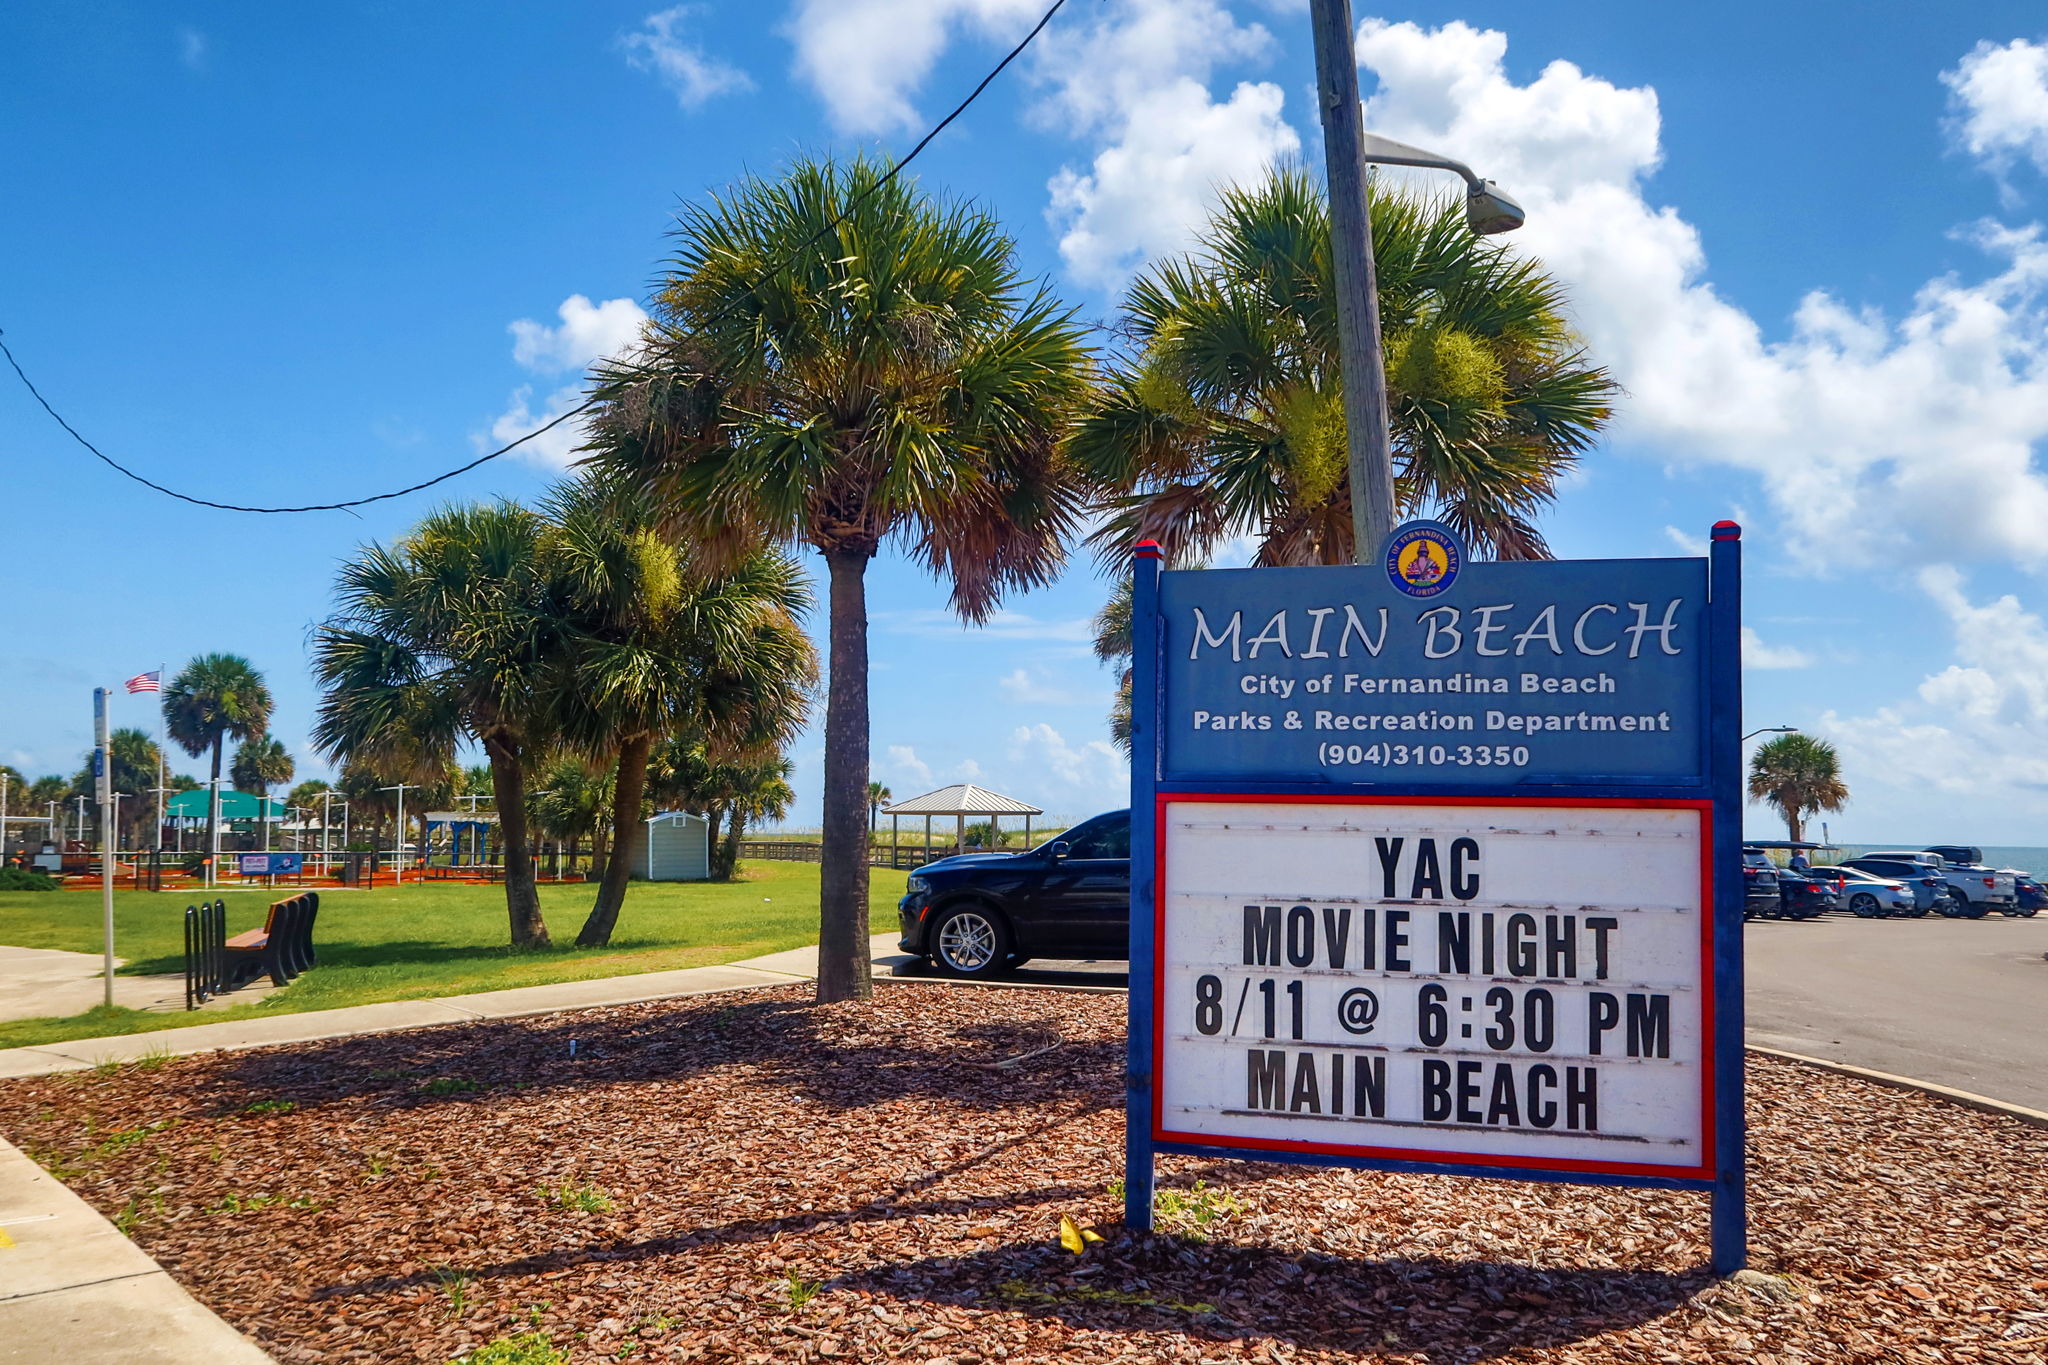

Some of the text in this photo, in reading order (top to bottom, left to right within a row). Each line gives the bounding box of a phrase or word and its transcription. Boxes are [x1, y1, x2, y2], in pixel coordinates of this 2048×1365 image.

[1391, 544, 1400, 555] OF
[1399, 530, 1449, 546] FERNANDINA
[1446, 546, 1457, 573] BEACH
[1407, 585, 1441, 596] FLORIDA
[1189, 598, 1683, 663] MAIN BEACH
[1240, 673, 1616, 699] City of Fernandina Beach
[1193, 710, 1670, 735] Parks & Recreation Department
[1318, 742, 1530, 767] (904)310-3350
[1374, 836, 1481, 901] YAC
[1242, 905, 1619, 981] MOVIE NIGHT
[1194, 974, 1671, 1060] 8/11 @ 6:30 PM
[1246, 1049, 1599, 1132] MAIN BEACH
